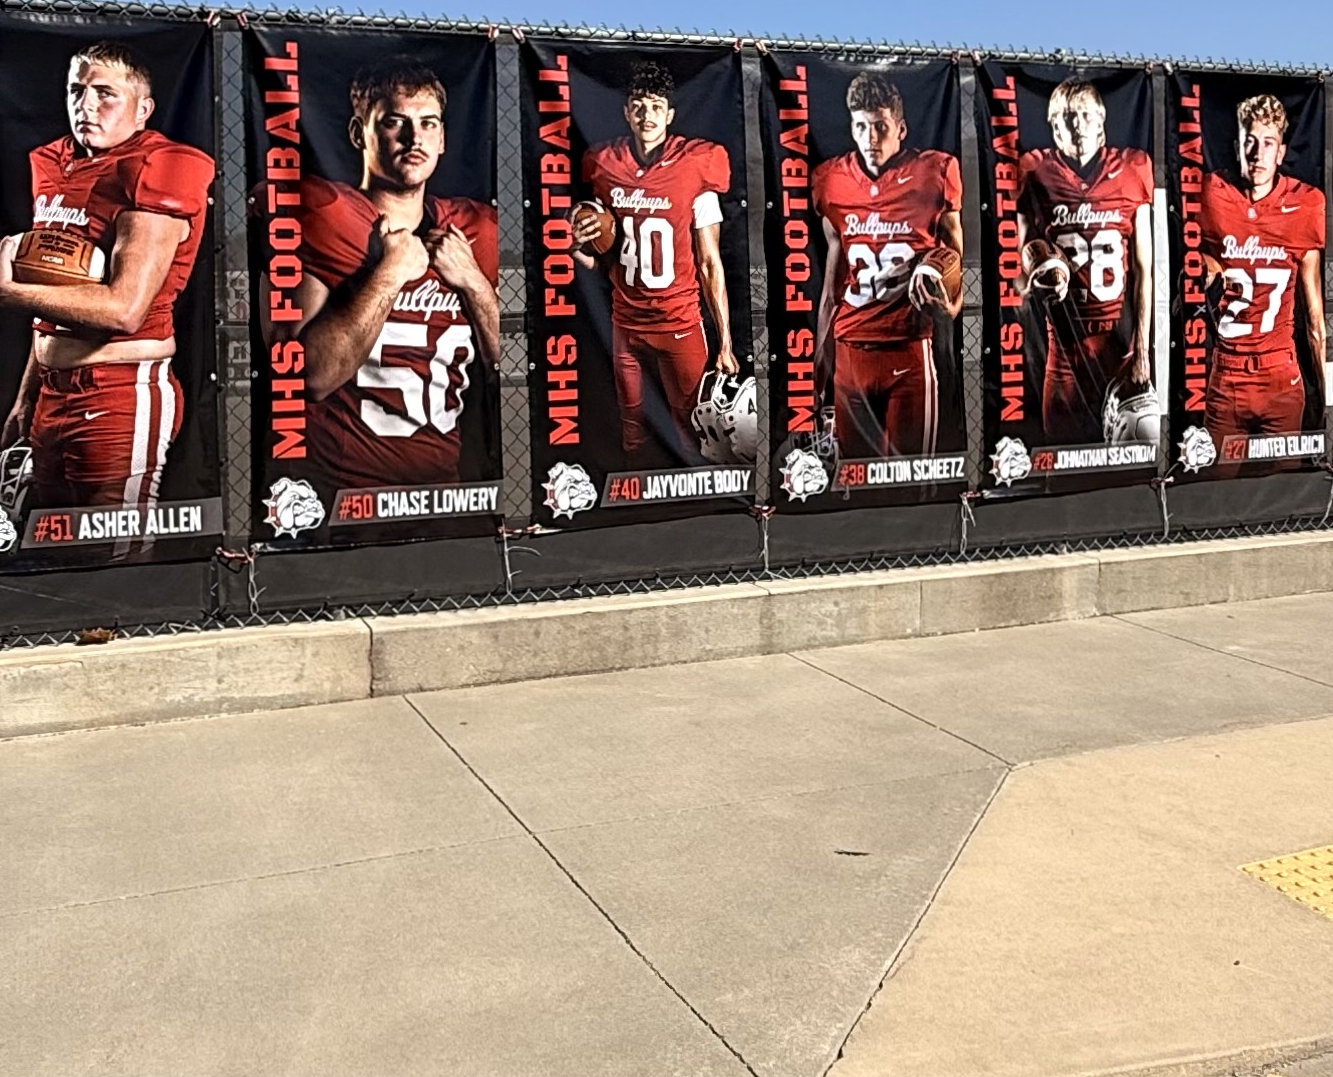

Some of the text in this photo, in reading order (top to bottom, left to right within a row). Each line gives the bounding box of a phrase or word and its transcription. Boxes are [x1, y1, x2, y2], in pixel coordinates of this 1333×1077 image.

[611, 187, 672, 211] Bullpups
[1051, 203, 1124, 229] Bullpups
[844, 212, 912, 240] Bullpups
[265, 41, 306, 459] MHS FOOTBALL
[538, 55, 581, 446] MHS FOOTBALL
[620, 217, 675, 289] 40
[779, 65, 815, 432] MHS FOOTBALL
[991, 76, 1025, 422] MHS FOOTBALL
[1178, 84, 1206, 412] MHS FOOTBALL
[1221, 234, 1287, 263] Bullpups
[844, 243, 915, 308] 38
[1218, 268, 1291, 338] 27
[357, 322, 475, 438] 50
[1034, 445, 1156, 470] #28 JOHNATHAN SEASTROM
[1225, 440, 1246, 460] #27
[1248, 436, 1286, 460] HUNTER
[609, 471, 751, 500] #40 JAYVONTE BODY
[839, 457, 965, 486] #38 COLTON SCHEETZ
[339, 486, 499, 520] #50 CHASE LOWERY
[33, 506, 202, 541] #51 ASHER ALLEN
